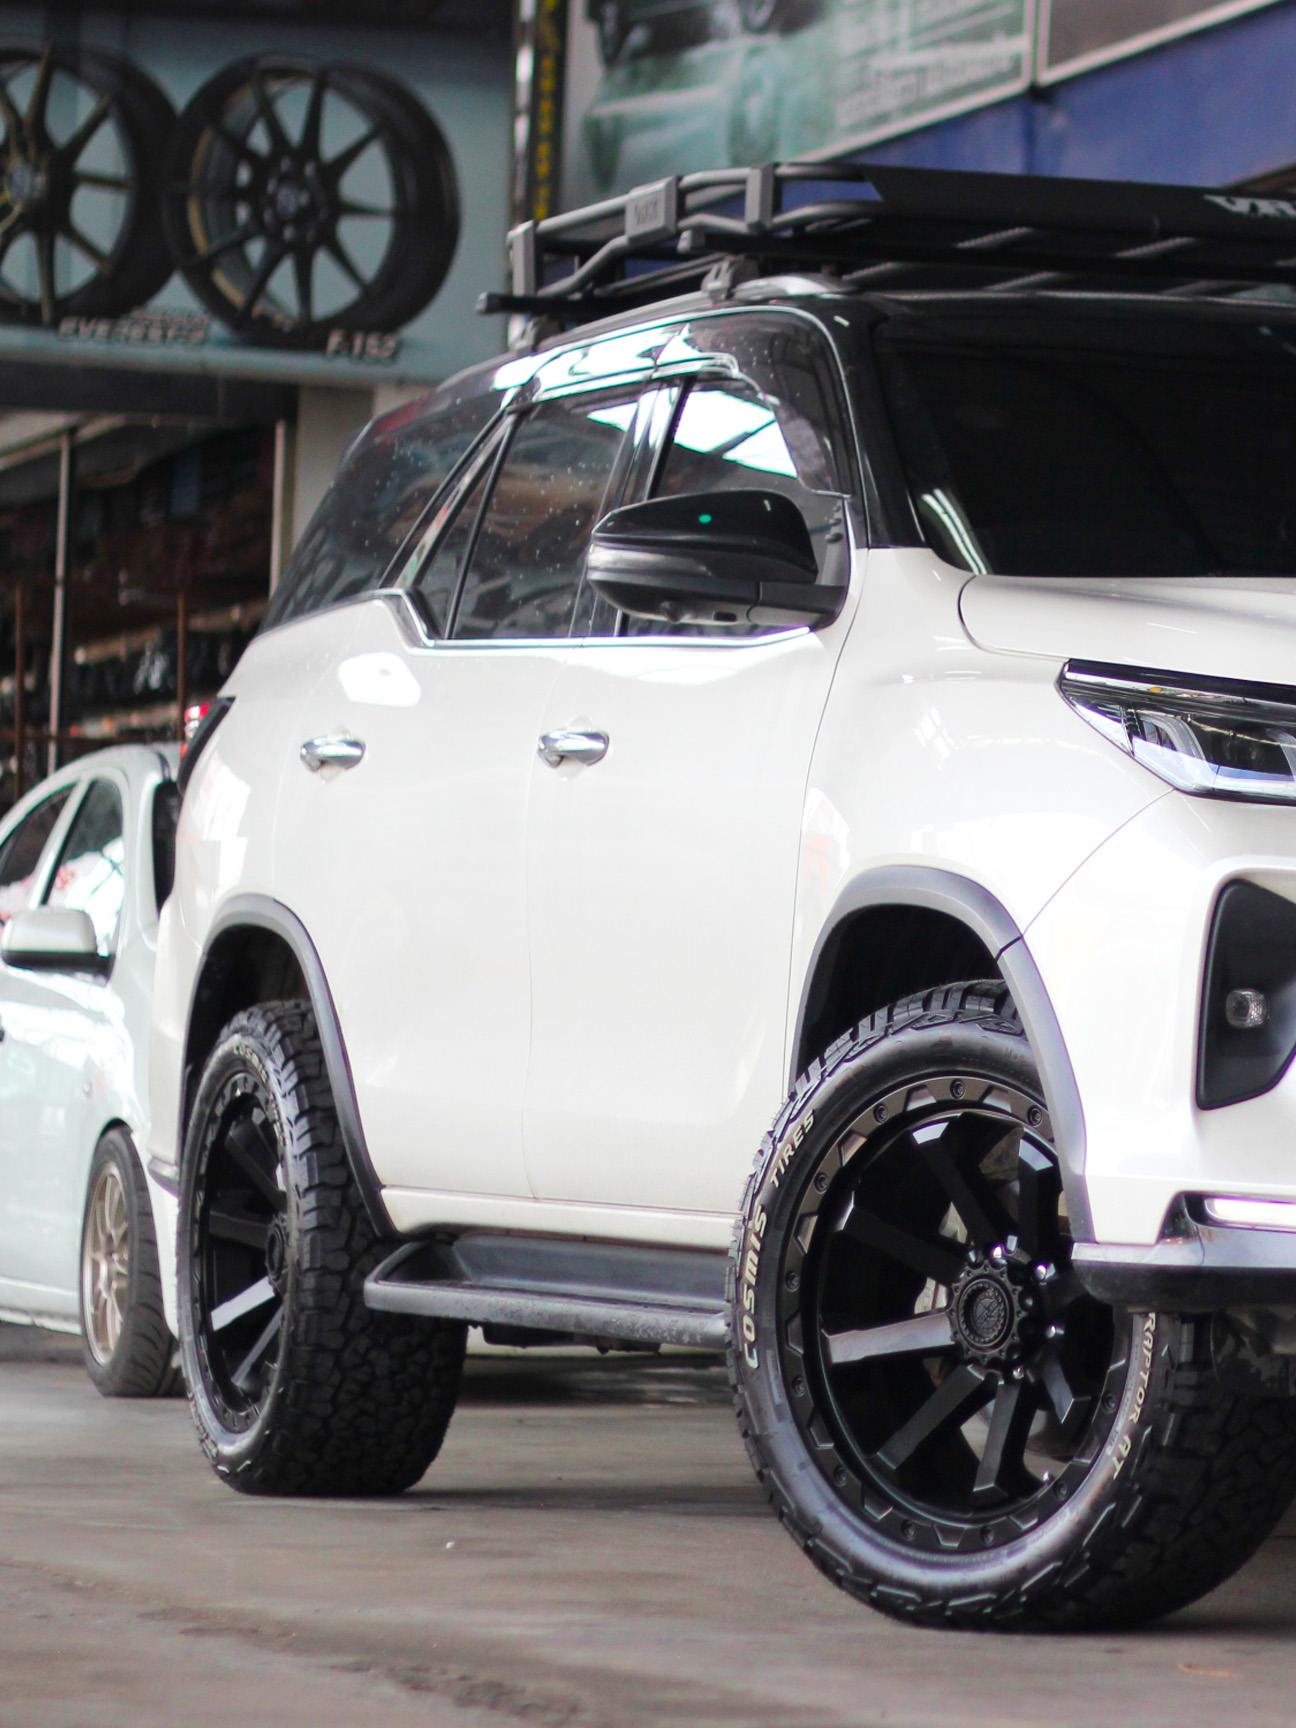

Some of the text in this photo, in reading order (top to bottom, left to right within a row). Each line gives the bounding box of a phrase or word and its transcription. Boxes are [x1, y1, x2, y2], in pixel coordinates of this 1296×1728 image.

[742, 1108, 816, 1370] COSMIS TIRES
[1126, 1312, 1156, 1424] RAPTOR
